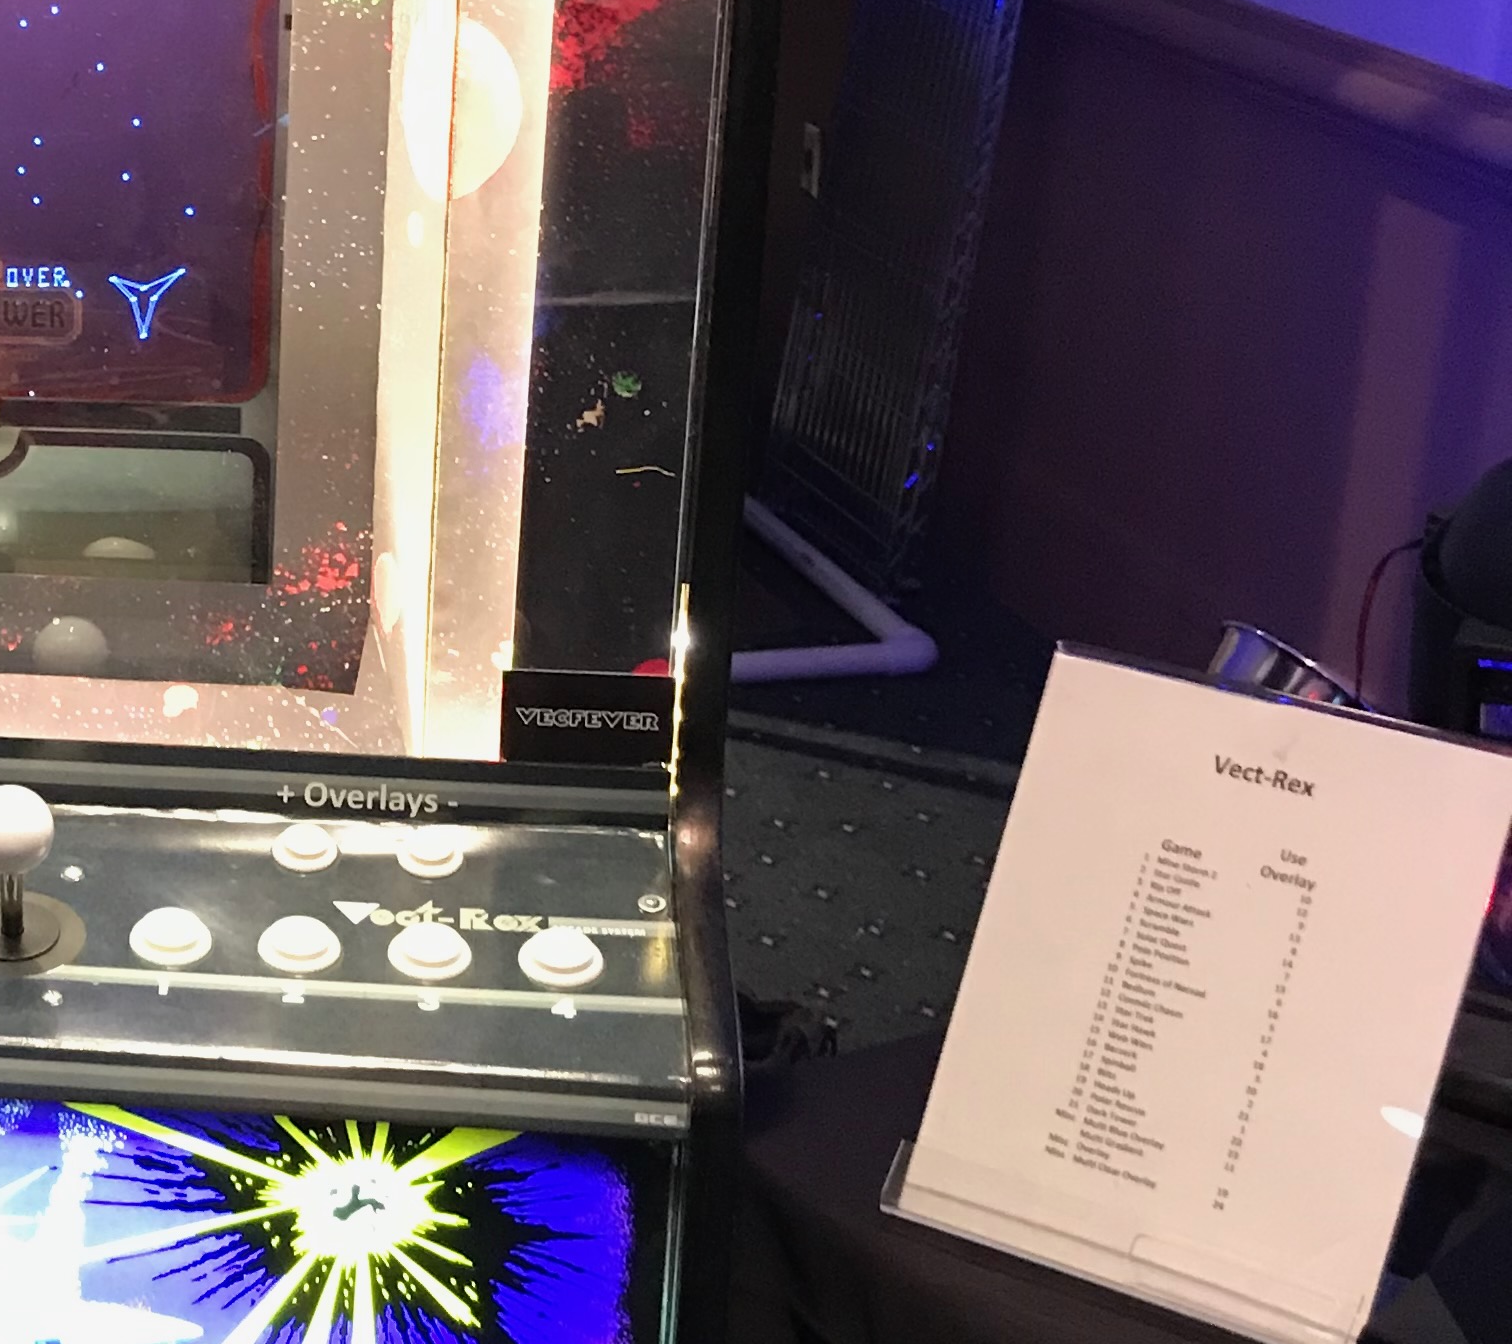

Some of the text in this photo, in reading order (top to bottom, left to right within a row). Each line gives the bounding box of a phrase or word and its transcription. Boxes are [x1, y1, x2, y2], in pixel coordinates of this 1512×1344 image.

[515, 706, 659, 731] VECFEVER
[1215, 754, 1315, 797] Vect-Rex
[303, 781, 439, 818] Overlays
[1161, 839, 1202, 860] Game
[1280, 849, 1307, 866] Use
[1260, 865, 1316, 892] Overlay
